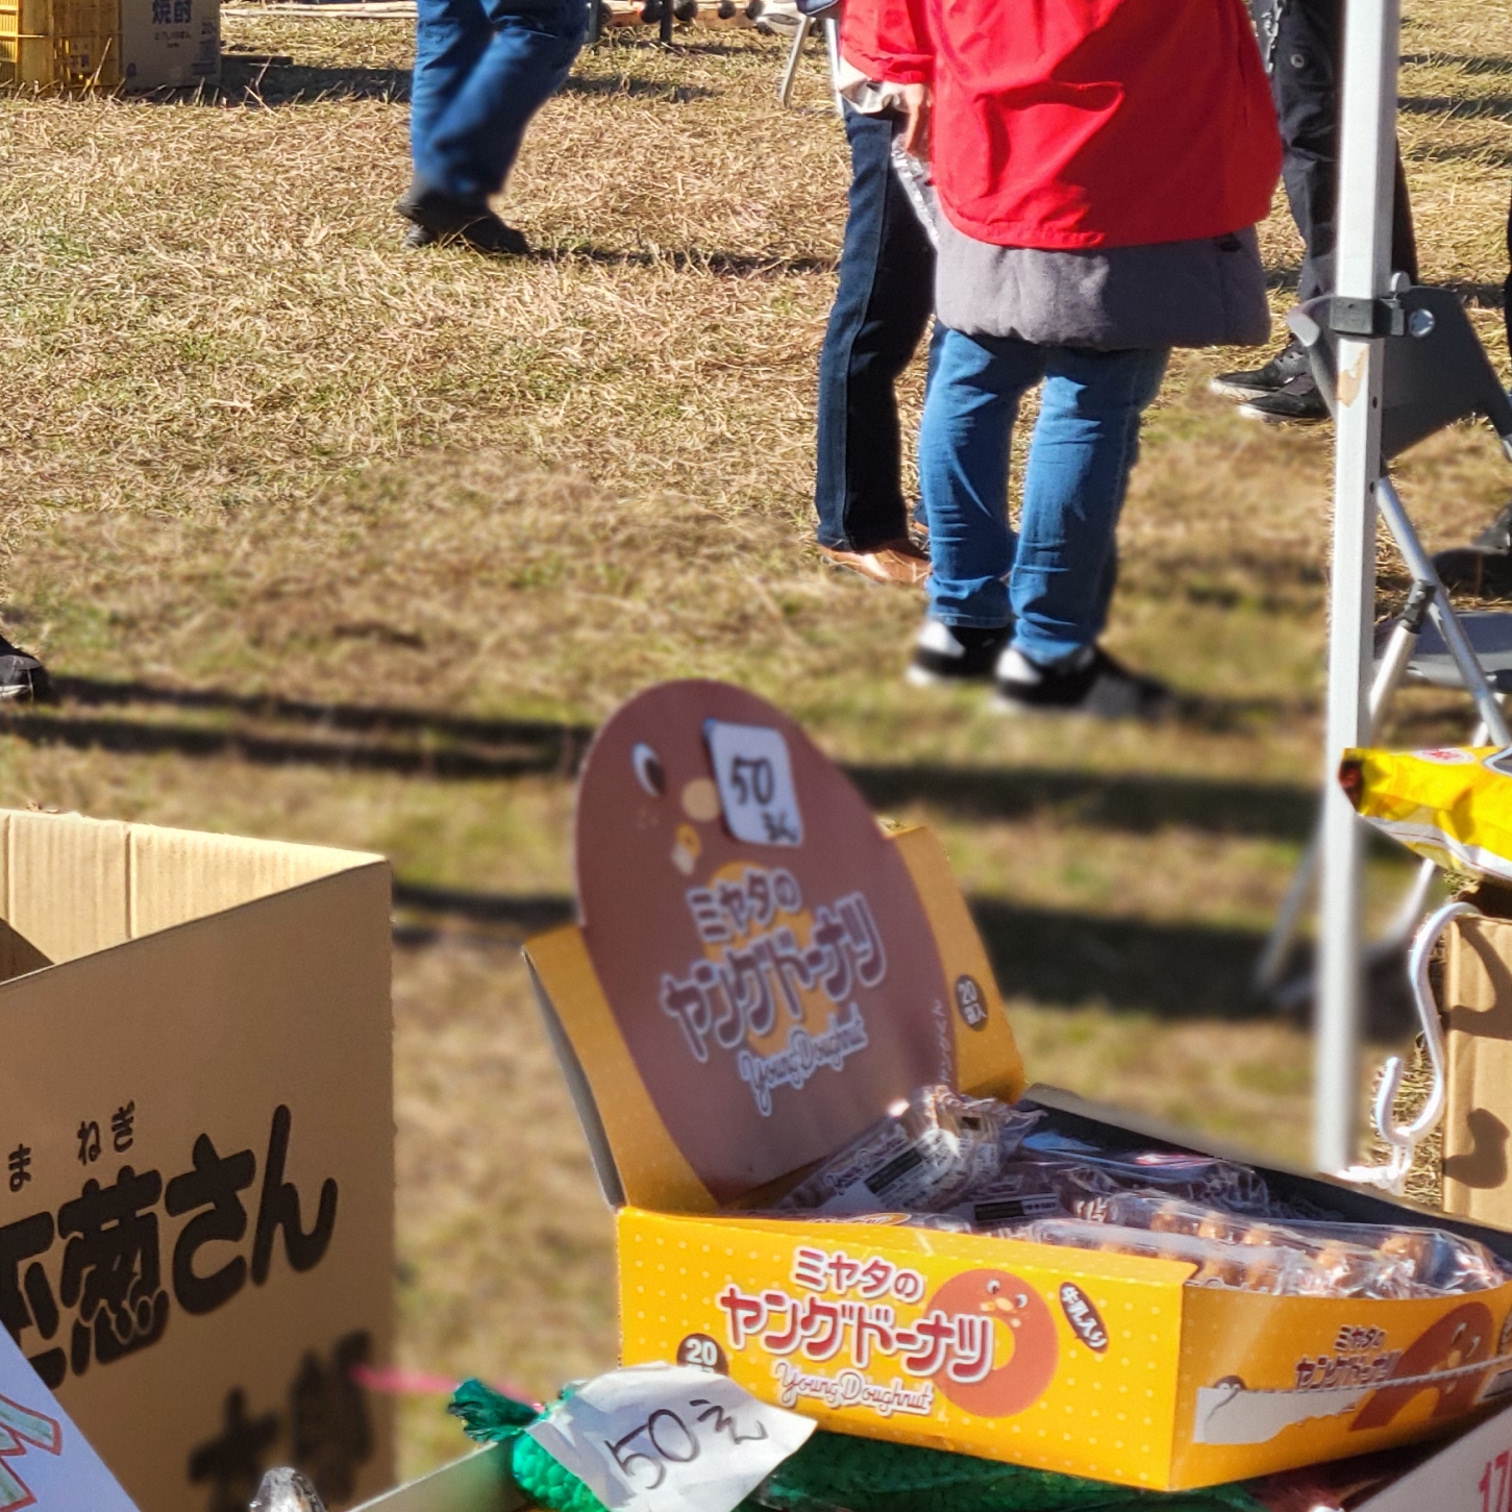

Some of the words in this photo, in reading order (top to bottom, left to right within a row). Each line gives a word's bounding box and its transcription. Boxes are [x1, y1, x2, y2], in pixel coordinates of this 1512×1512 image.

[730, 755, 776, 807] 50
[686, 867, 802, 942] ミヤタの
[660, 892, 886, 1064] ヤングドーナツ
[791, 1246, 924, 1302] ミヤタの
[717, 1287, 996, 1384] ヤングドーナツ
[1062, 1286, 1108, 1348] 牛乳入り
[685, 1338, 718, 1366] 20
[774, 1362, 843, 1408] Young
[832, 1368, 936, 1417] Doughnut
